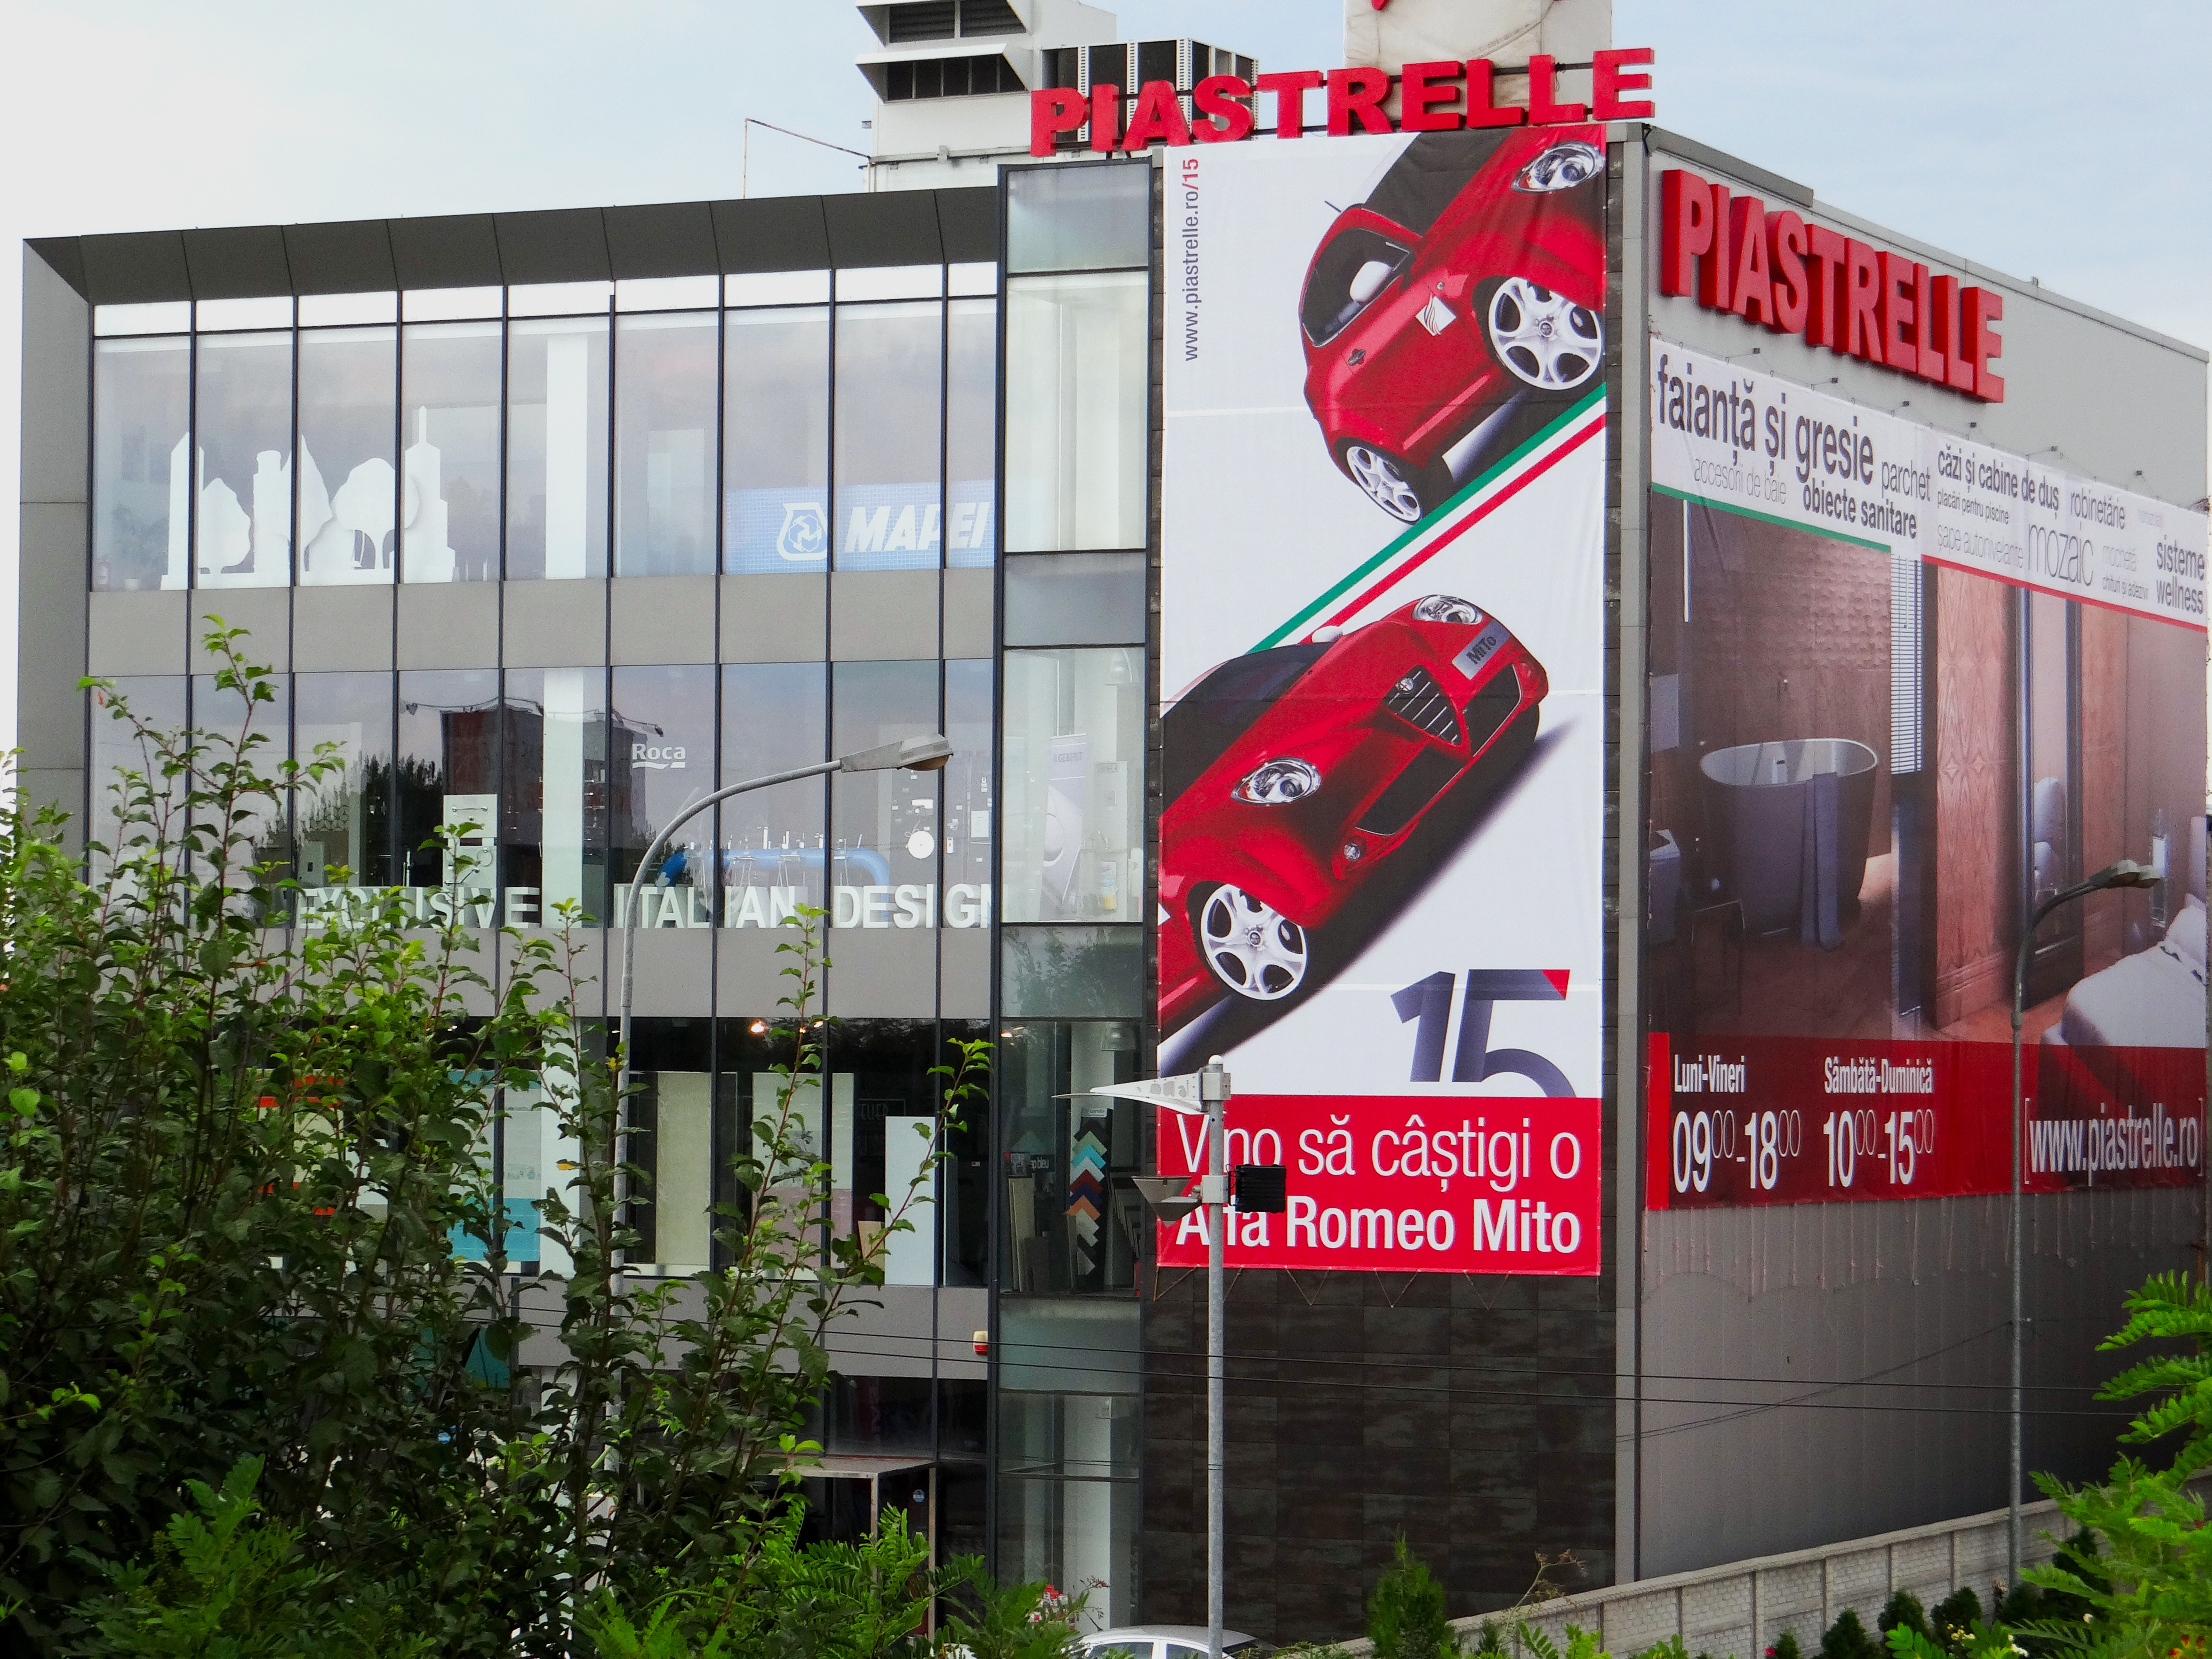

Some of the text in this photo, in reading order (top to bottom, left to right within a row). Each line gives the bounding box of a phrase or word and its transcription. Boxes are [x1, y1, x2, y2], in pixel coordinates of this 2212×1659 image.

[1030, 47, 1655, 157] PIASTRELLE
[1182, 159, 1202, 361] www.piastrelle.ro/15
[1661, 169, 2005, 403] PIASTRELLE
[1795, 416, 1874, 485] gresie
[1695, 458, 1786, 505] accesorii de baie
[1882, 459, 1931, 501] parchet
[1978, 459, 2018, 498] cabine
[2021, 470, 2035, 501] de
[844, 502, 990, 553] MAPEI
[1803, 478, 1917, 539] obiecte sanitare
[1962, 496, 1984, 518] pentru
[1985, 504, 2009, 525] piscine
[2027, 522, 2094, 587] mozaic
[2156, 535, 2205, 581] sisteme
[2156, 579, 2203, 615] wellness
[633, 743, 686, 761] Roca
[614, 884, 796, 929] ITALIAN
[1390, 969, 1577, 1098] 15
[1674, 1054, 1746, 1094] Luni-Vineri
[1176, 1114, 1281, 1172] Vno
[1298, 1114, 1355, 1176] să
[1550, 1132, 1580, 1179] o
[2029, 1102, 2198, 1187] www.piastrelle.ro
[1176, 1194, 1580, 1254] Afa Romeo Mito
